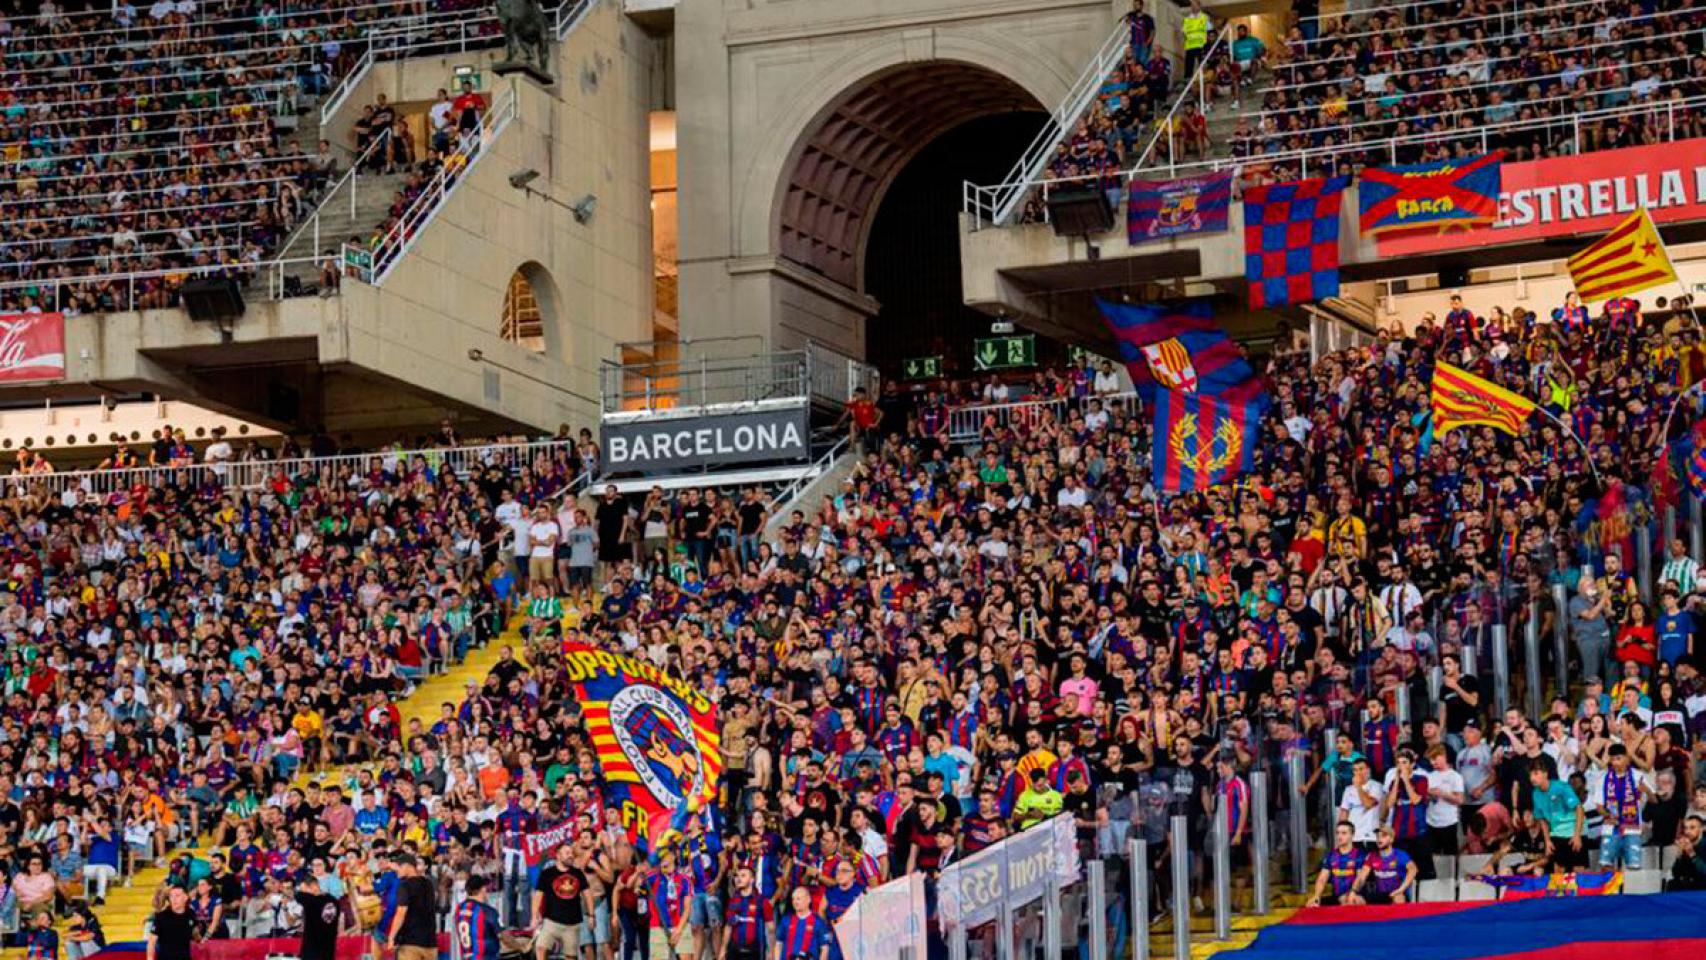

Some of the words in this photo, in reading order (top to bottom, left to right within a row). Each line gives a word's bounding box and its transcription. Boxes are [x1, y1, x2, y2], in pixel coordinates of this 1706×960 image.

[1493, 169, 1687, 228] ESTRELLA
[609, 421, 803, 463] BARCELONA
[458, 921, 471, 948] 8
